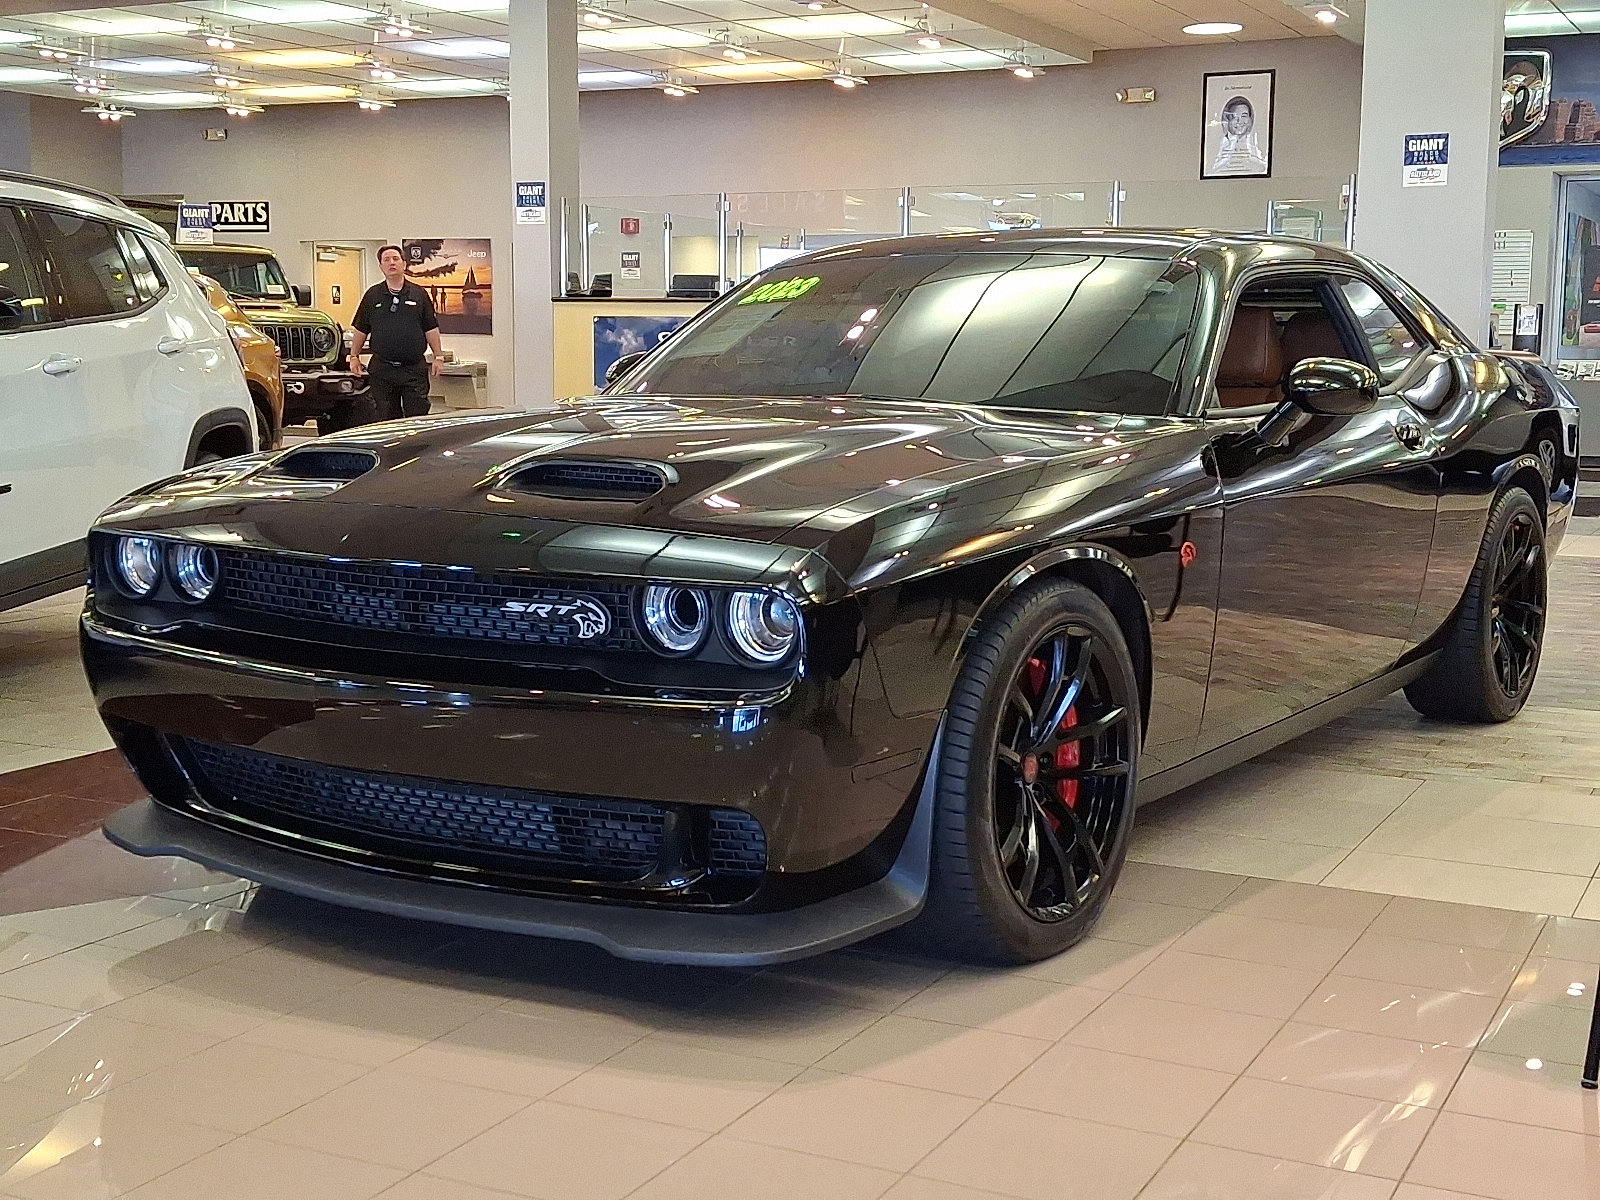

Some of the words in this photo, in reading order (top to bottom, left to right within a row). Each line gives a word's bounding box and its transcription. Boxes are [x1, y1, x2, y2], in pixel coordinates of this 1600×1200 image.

[1408, 138, 1446, 152] GIANT
[518, 185, 543, 196] GIANT
[182, 207, 210, 218] GIANT
[211, 202, 267, 223] PARTS
[467, 249, 487, 259] Jeep
[499, 601, 579, 618] SRT
